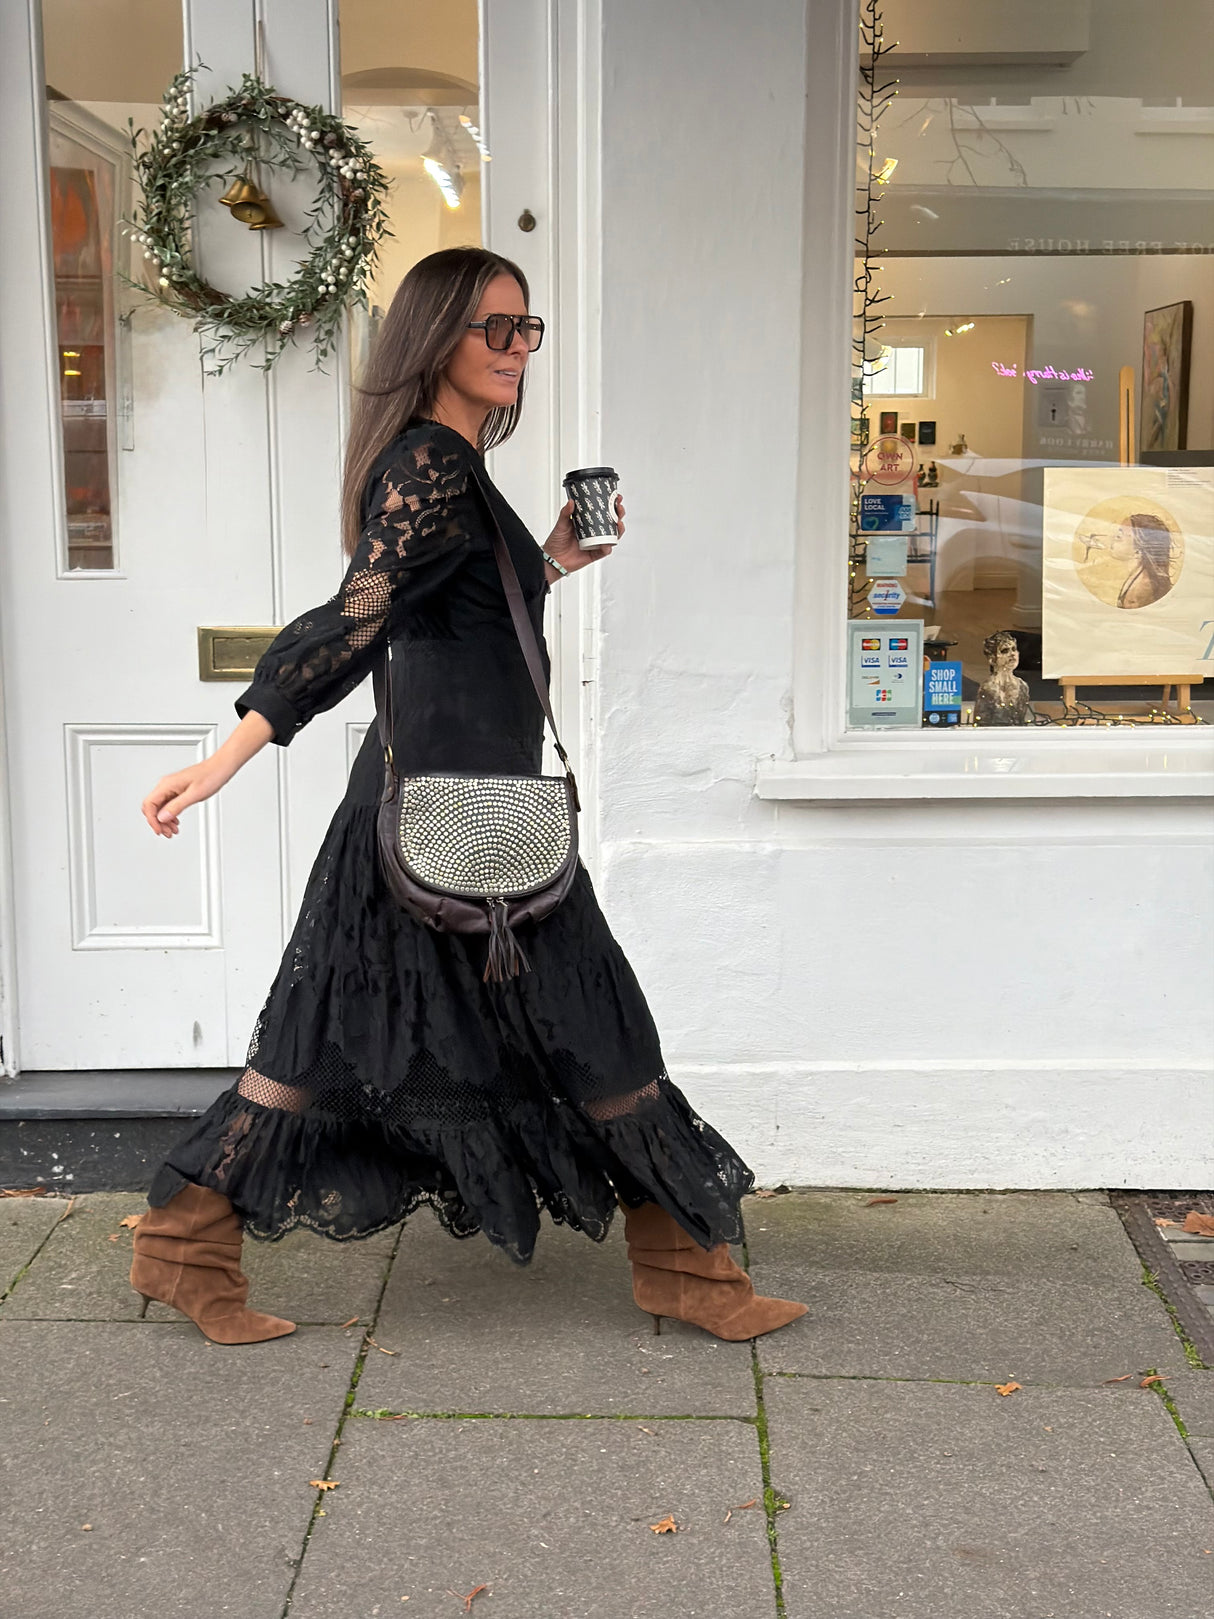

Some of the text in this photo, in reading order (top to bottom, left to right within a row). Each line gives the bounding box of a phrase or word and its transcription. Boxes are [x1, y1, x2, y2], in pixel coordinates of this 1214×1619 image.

[877, 452, 904, 461] OWN
[880, 463, 900, 472] ART
[931, 669, 956, 681] SHOP
[928, 681, 958, 693] SMALL
[932, 693, 955, 705] HERE
